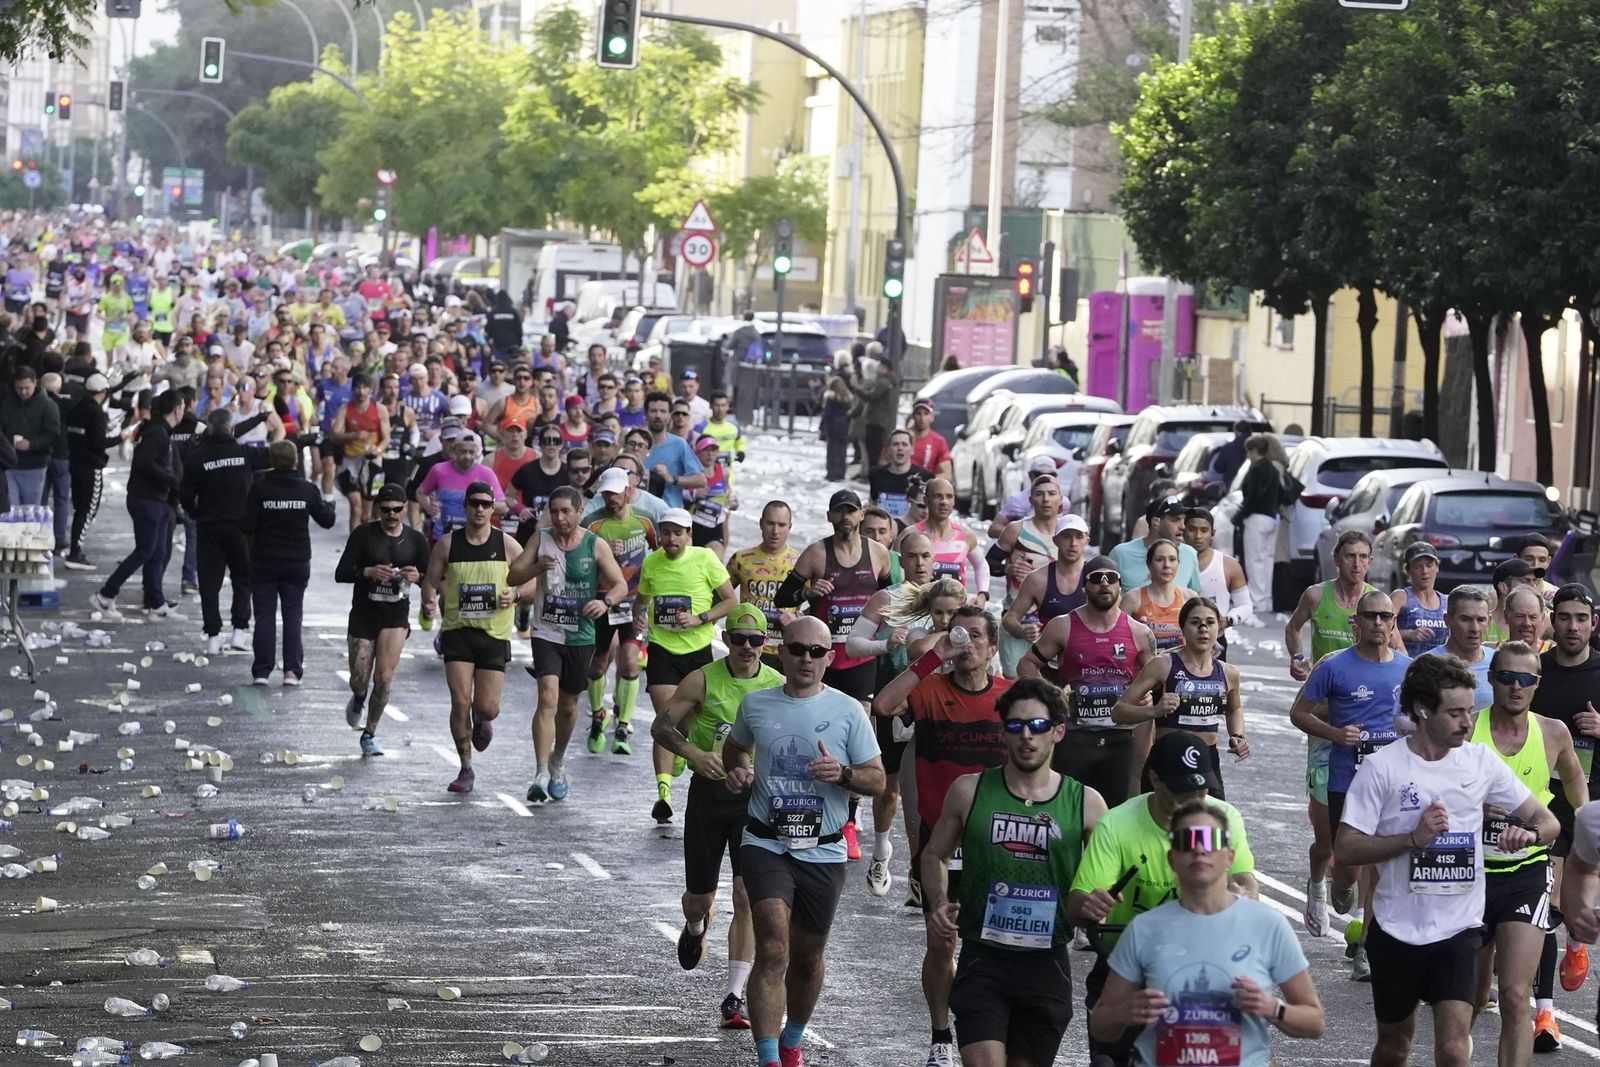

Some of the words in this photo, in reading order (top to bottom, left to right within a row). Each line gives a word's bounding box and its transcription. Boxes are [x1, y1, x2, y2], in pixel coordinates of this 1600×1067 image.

[688, 243, 708, 255] 30
[203, 457, 245, 471] VOLUNTEER
[263, 501, 307, 509] VOLUNTEER
[462, 602, 484, 610] DAVID
[559, 615, 579, 624] CRUZ
[836, 625, 852, 634] JOR
[1092, 685, 1119, 693] ZURICH
[1078, 707, 1113, 717] VALVER
[1190, 704, 1218, 715] MARÍA
[1372, 731, 1398, 739] ZURICH
[767, 779, 816, 794] SEVILLA
[787, 814, 805, 822] 5227
[777, 825, 815, 836] SERGEY
[992, 820, 1048, 850] GAMA
[1435, 836, 1470, 845] ZURICH
[1436, 855, 1456, 864] 4152
[1412, 866, 1474, 880] ARMANDO
[1012, 887, 1051, 899] ZURICH
[1010, 905, 1033, 916] 5843
[988, 913, 1050, 933] AURÉLIEN
[1183, 1010, 1231, 1021] ZURICH
[1176, 1047, 1219, 1065] JANA
